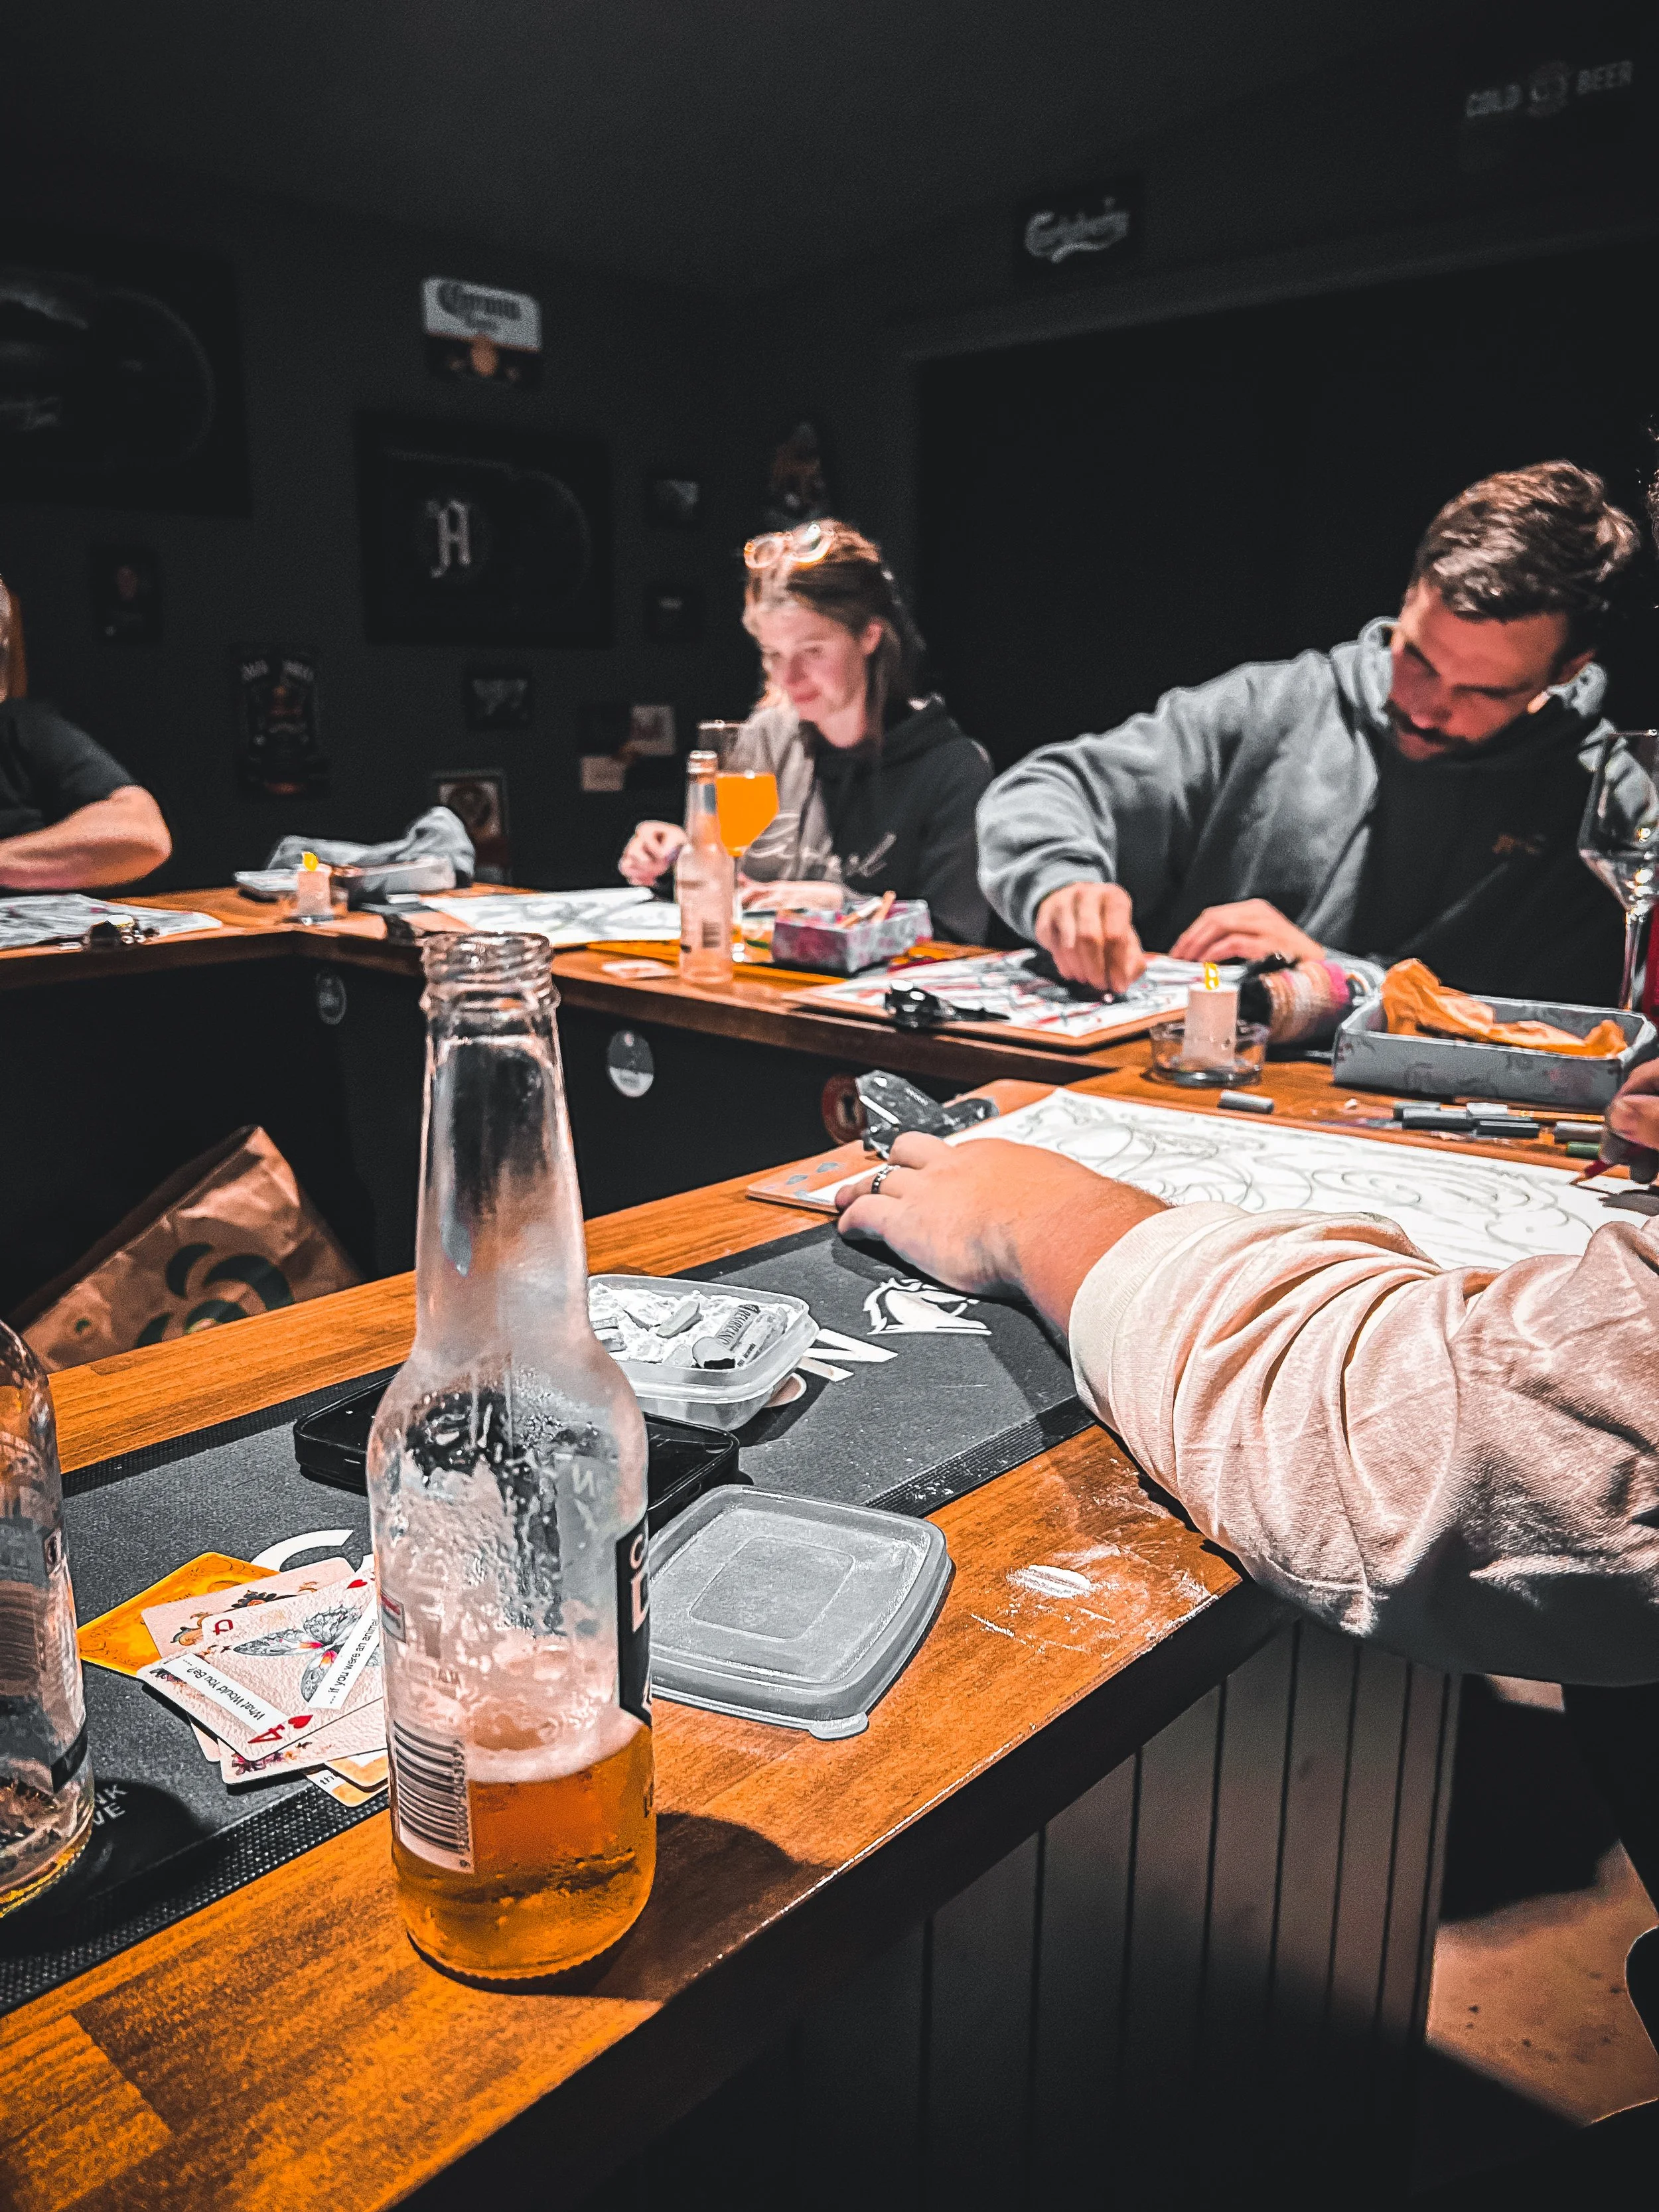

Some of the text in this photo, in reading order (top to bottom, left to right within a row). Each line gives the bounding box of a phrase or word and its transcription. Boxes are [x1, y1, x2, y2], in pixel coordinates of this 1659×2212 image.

[334, 1670, 348, 1686] you
[344, 1653, 359, 1670] were
[357, 1641, 367, 1652] an
[204, 1676, 220, 1688] You
[216, 1685, 244, 1705] Would
[240, 1702, 265, 1720] What
